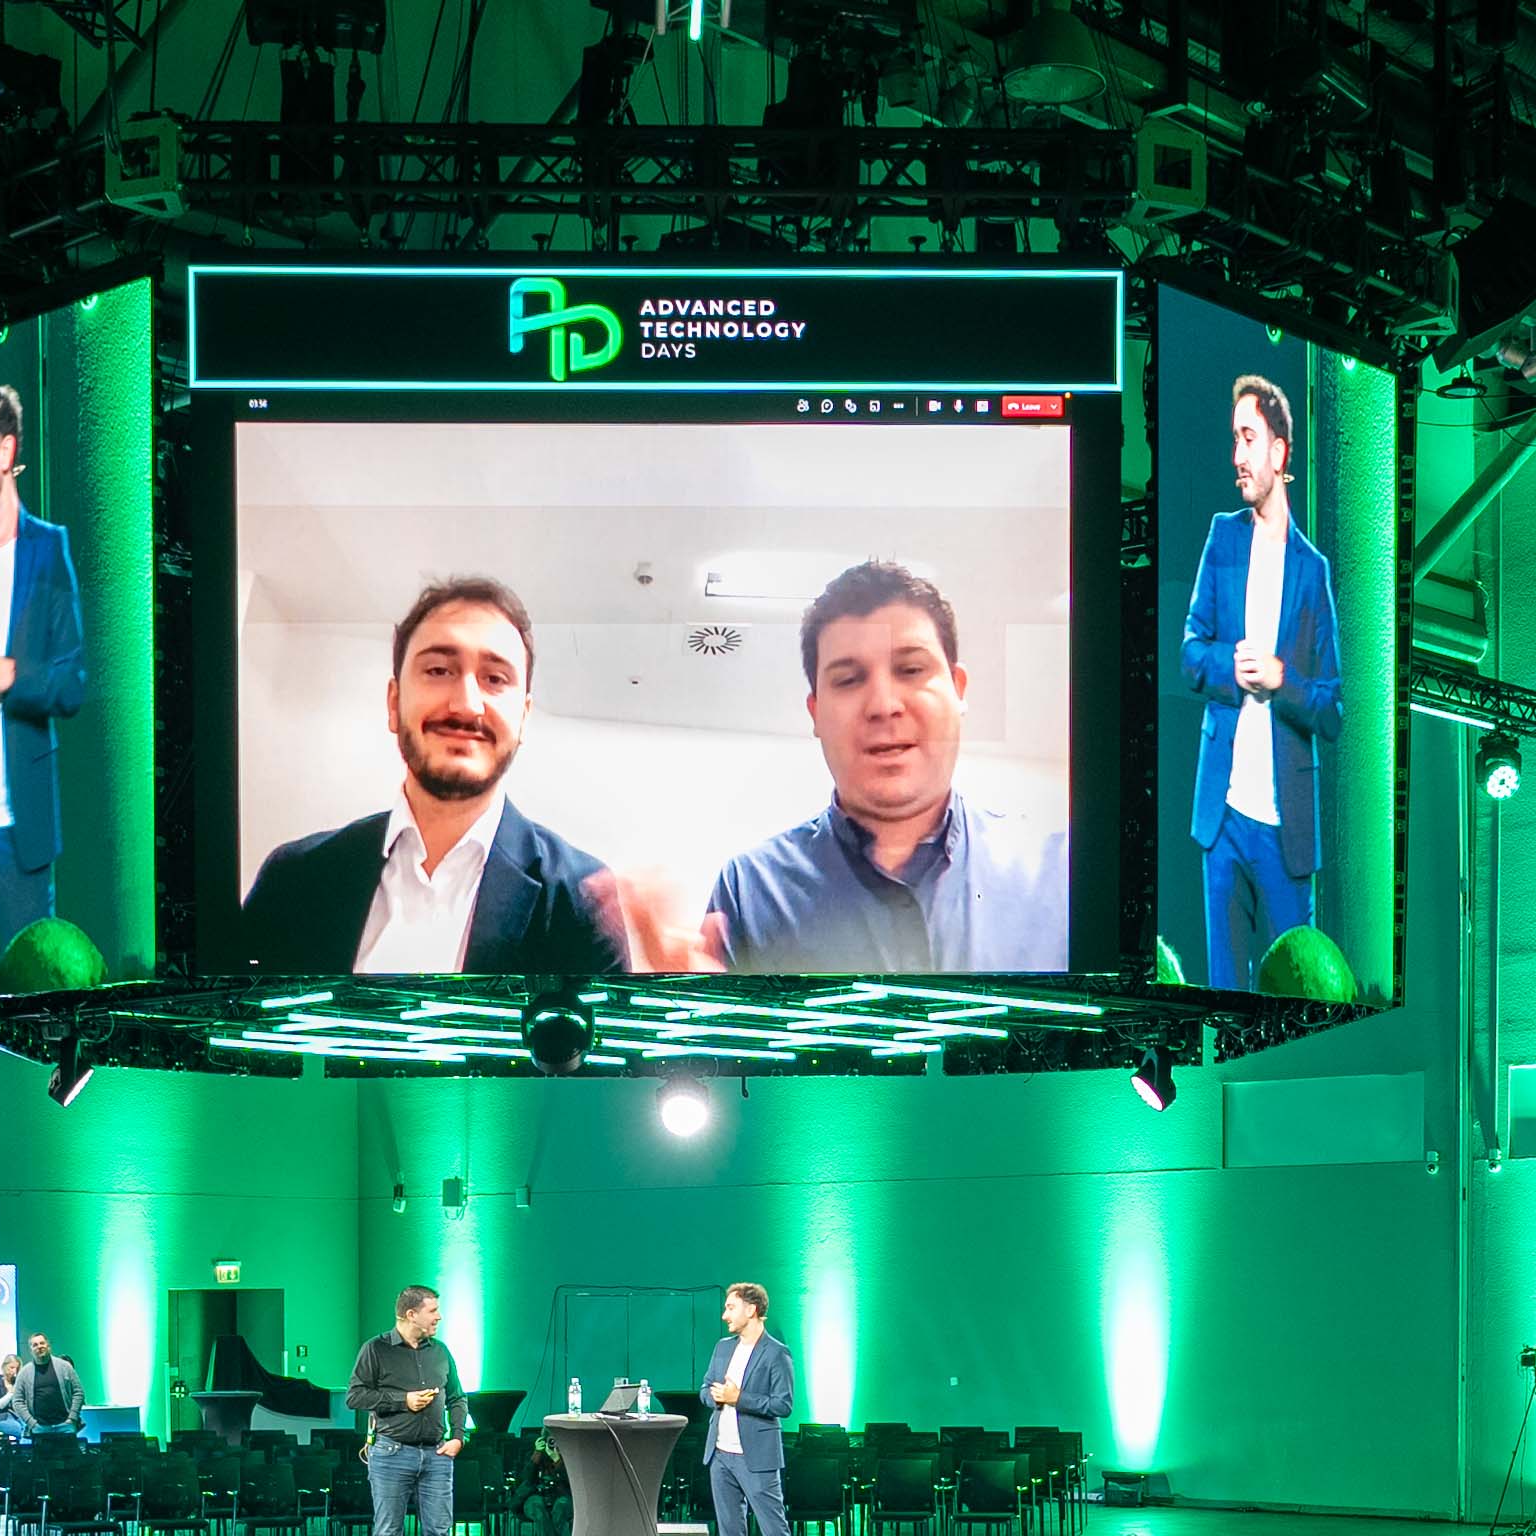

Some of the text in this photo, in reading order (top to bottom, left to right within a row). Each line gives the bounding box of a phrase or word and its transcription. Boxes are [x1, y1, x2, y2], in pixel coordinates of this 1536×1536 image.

[639, 299, 775, 316] ADVANCED
[639, 321, 806, 339] TECHNOLOGY
[641, 342, 696, 359] DAYS
